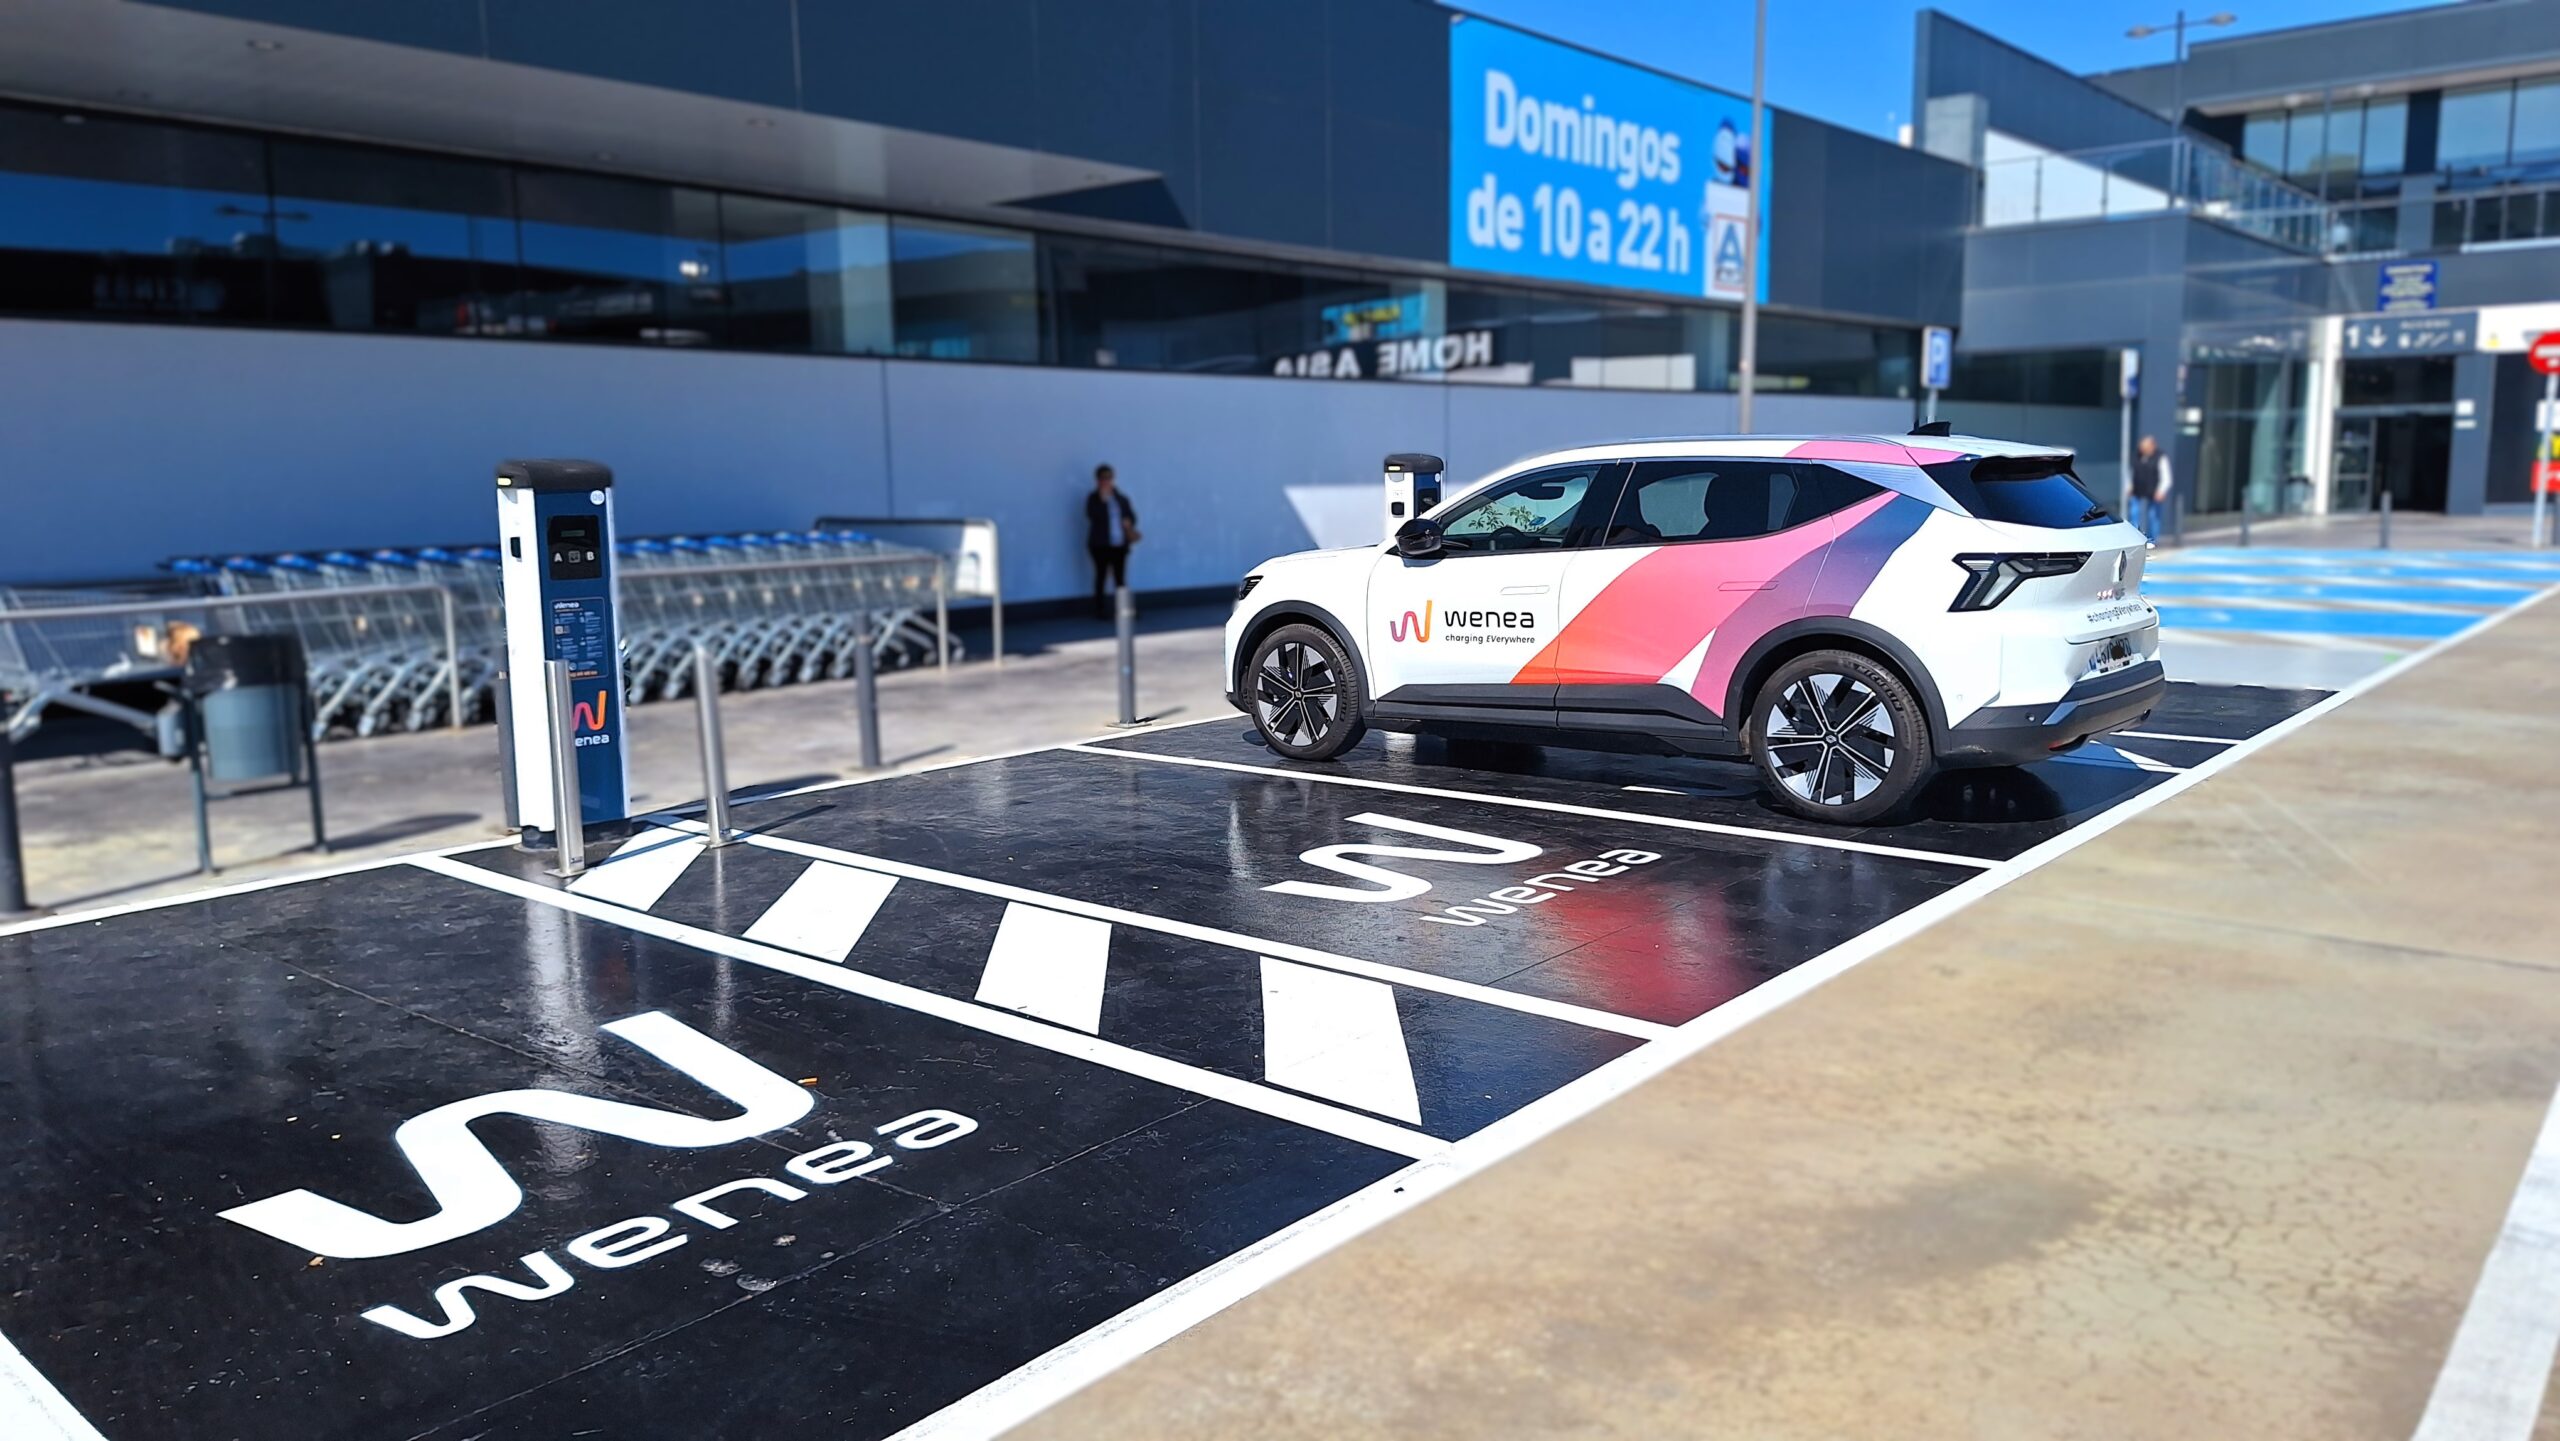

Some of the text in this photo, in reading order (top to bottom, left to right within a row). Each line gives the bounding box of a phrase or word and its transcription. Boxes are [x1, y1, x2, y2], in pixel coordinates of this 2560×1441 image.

[1485, 68, 1681, 190] Domingos
[1467, 173, 1690, 274] de 10 a 22 h
[554, 551, 595, 562] A B
[1445, 611, 1534, 628] wenea
[1445, 634, 1535, 645] charging EVerywhere
[573, 733, 610, 747] enea
[1418, 849, 1662, 927] wenea
[360, 1108, 980, 1340] wenea
